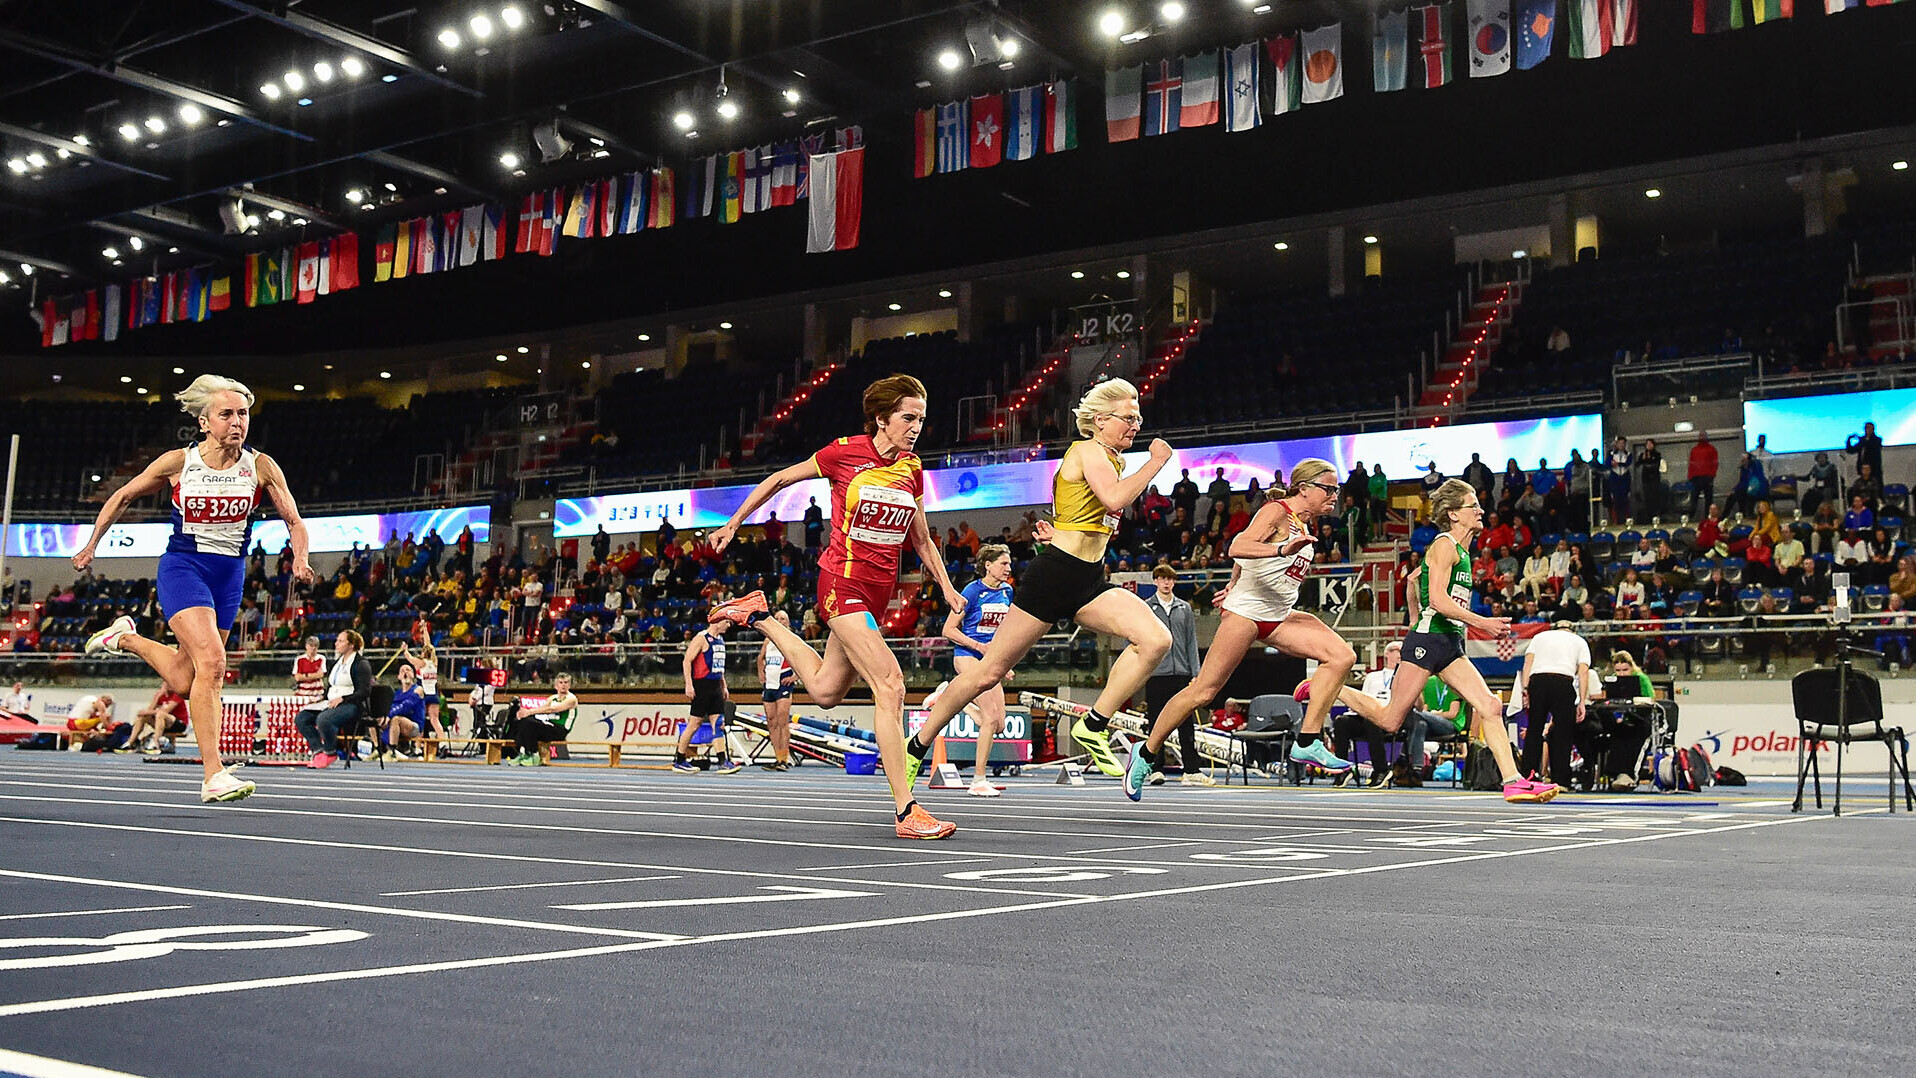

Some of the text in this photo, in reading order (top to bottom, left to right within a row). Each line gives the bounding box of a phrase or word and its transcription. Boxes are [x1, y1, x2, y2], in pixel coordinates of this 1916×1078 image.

[1077, 318, 1099, 338] J2
[1106, 313, 1134, 335] K2
[520, 404, 538, 422] H2
[186, 498, 249, 517] 65 3269
[191, 510, 202, 518] W
[860, 502, 913, 527] 65 2701
[862, 515, 873, 523] W
[1319, 576, 1354, 605] K1
[491, 669, 506, 687] 53
[1188, 847, 1372, 862] 5
[941, 864, 1170, 883] 6
[547, 885, 886, 912] 7
